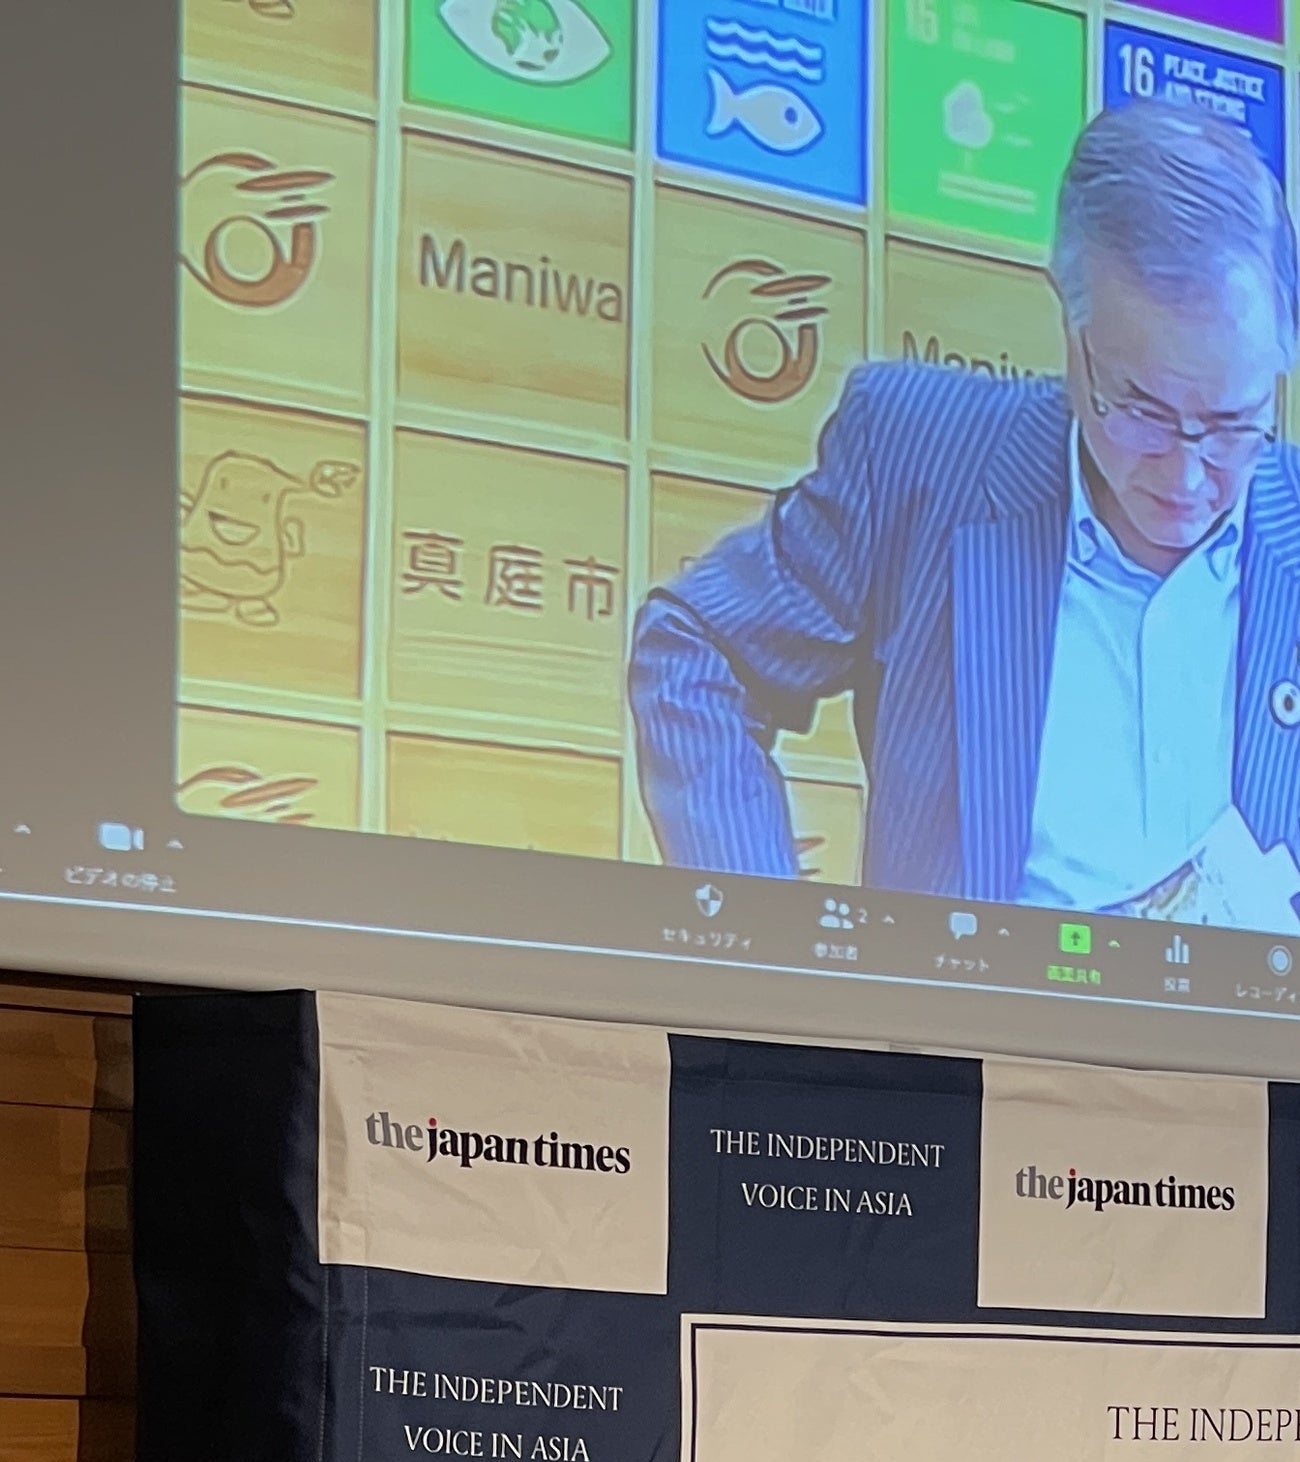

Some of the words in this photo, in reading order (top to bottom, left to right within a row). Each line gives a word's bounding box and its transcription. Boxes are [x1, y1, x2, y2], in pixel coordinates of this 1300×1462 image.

[1119, 43, 1154, 97] 16
[419, 234, 625, 322] Maniwa
[402, 530, 619, 621] 真庭市
[710, 1127, 762, 1159] THE
[765, 1131, 946, 1169] INDEPENDENT
[740, 1181, 821, 1214] VOICE
[824, 1185, 851, 1214] IN
[854, 1187, 914, 1219] ASIA
[370, 1366, 427, 1398] THE
[433, 1372, 624, 1413] INDEPENDENT
[402, 1424, 484, 1459] VOICE
[490, 1431, 524, 1460] IN
[1106, 1404, 1182, 1444] THE
